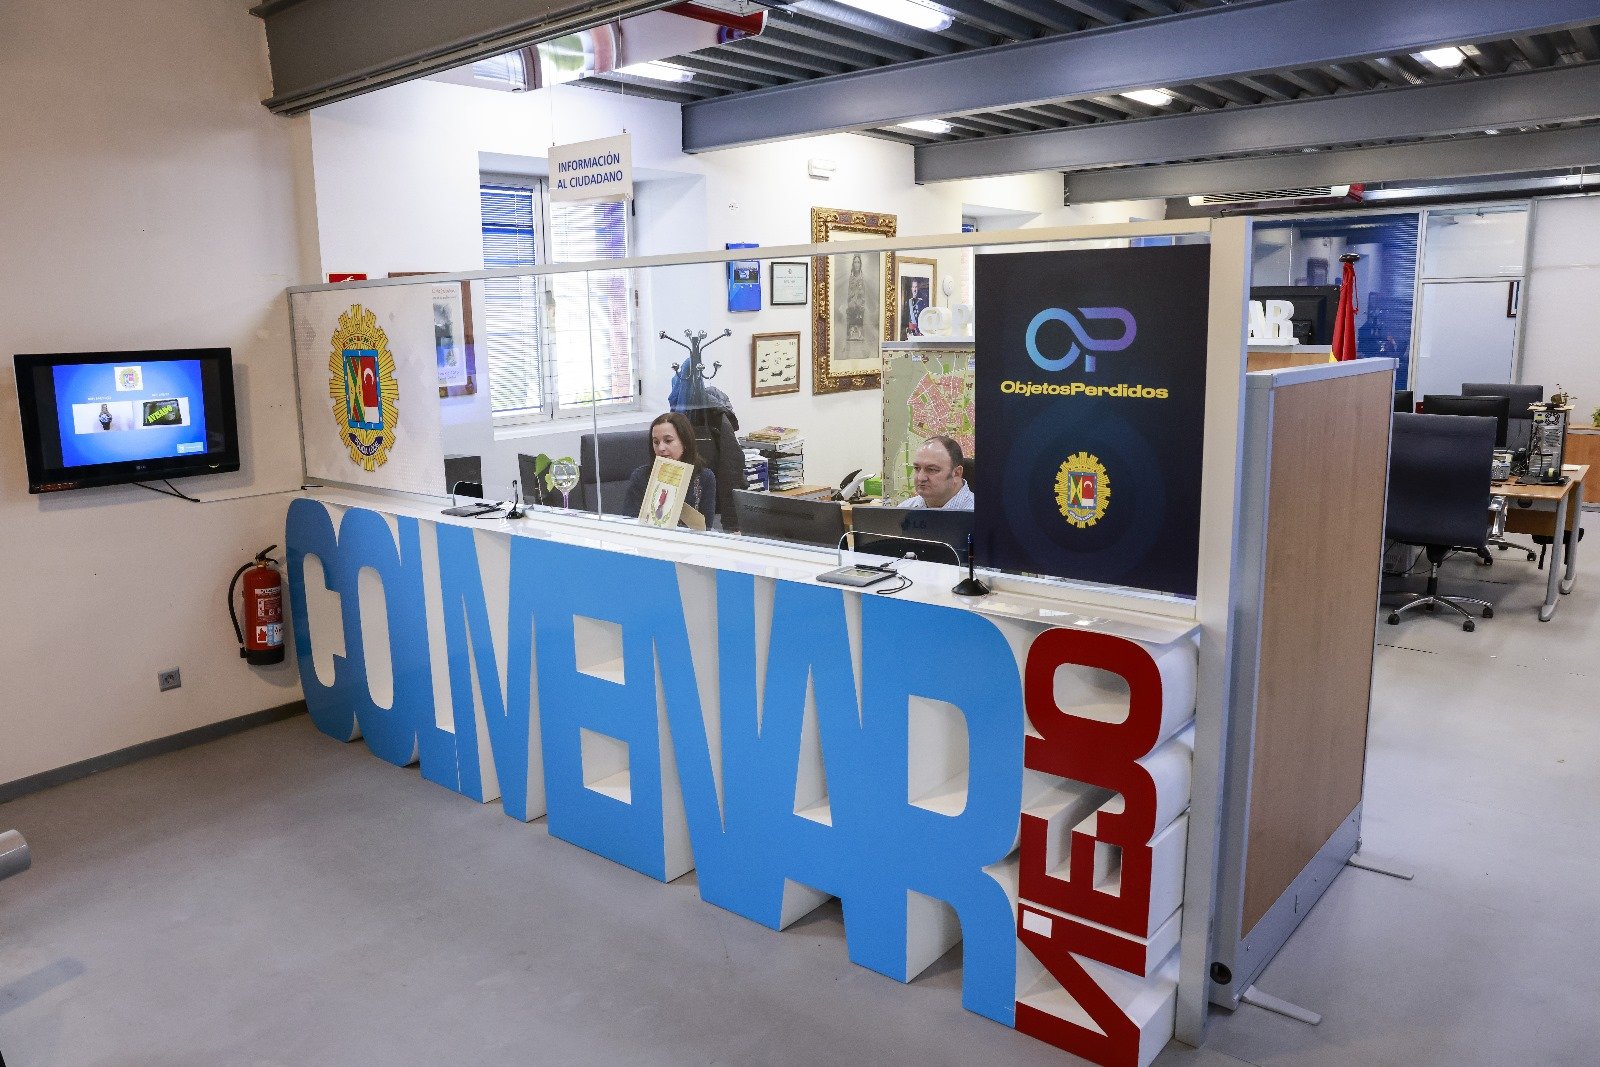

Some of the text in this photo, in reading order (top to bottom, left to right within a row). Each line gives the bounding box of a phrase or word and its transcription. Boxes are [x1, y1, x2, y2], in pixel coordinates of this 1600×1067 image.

[558, 151, 620, 173] INFORMACIÓN
[557, 170, 623, 189] AL CIUDADANO
[1000, 380, 1169, 399] ObjetosPerdidos
[286, 498, 1023, 1028] COLMENAR
